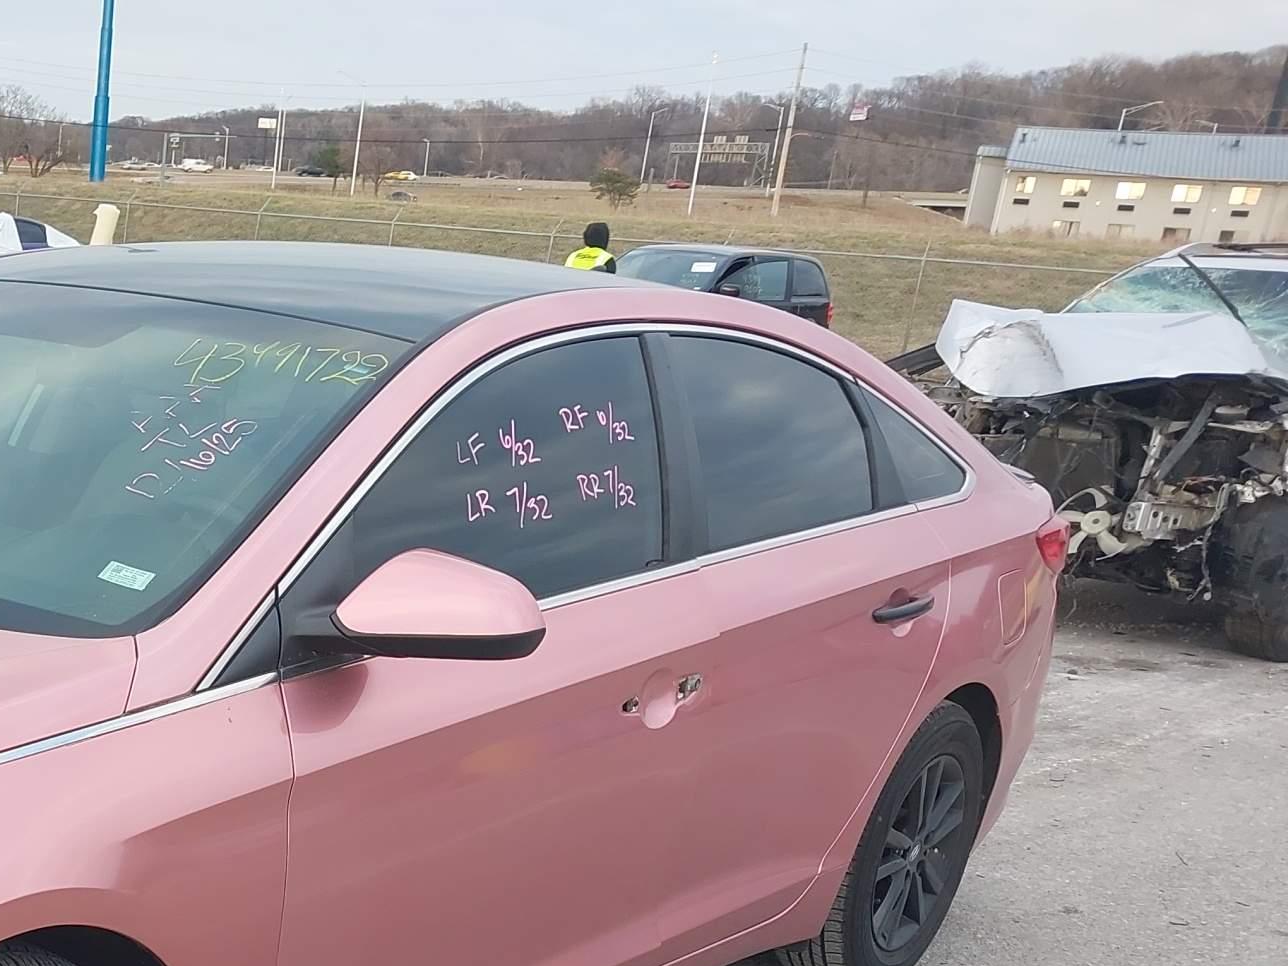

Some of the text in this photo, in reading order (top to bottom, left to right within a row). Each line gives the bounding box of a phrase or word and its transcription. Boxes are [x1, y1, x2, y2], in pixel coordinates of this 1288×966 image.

[559, 404, 589, 432] RF
[456, 419, 542, 467] LF 6/32
[467, 481, 552, 529] LR 7/32
[577, 465, 637, 509] RR 7/32
